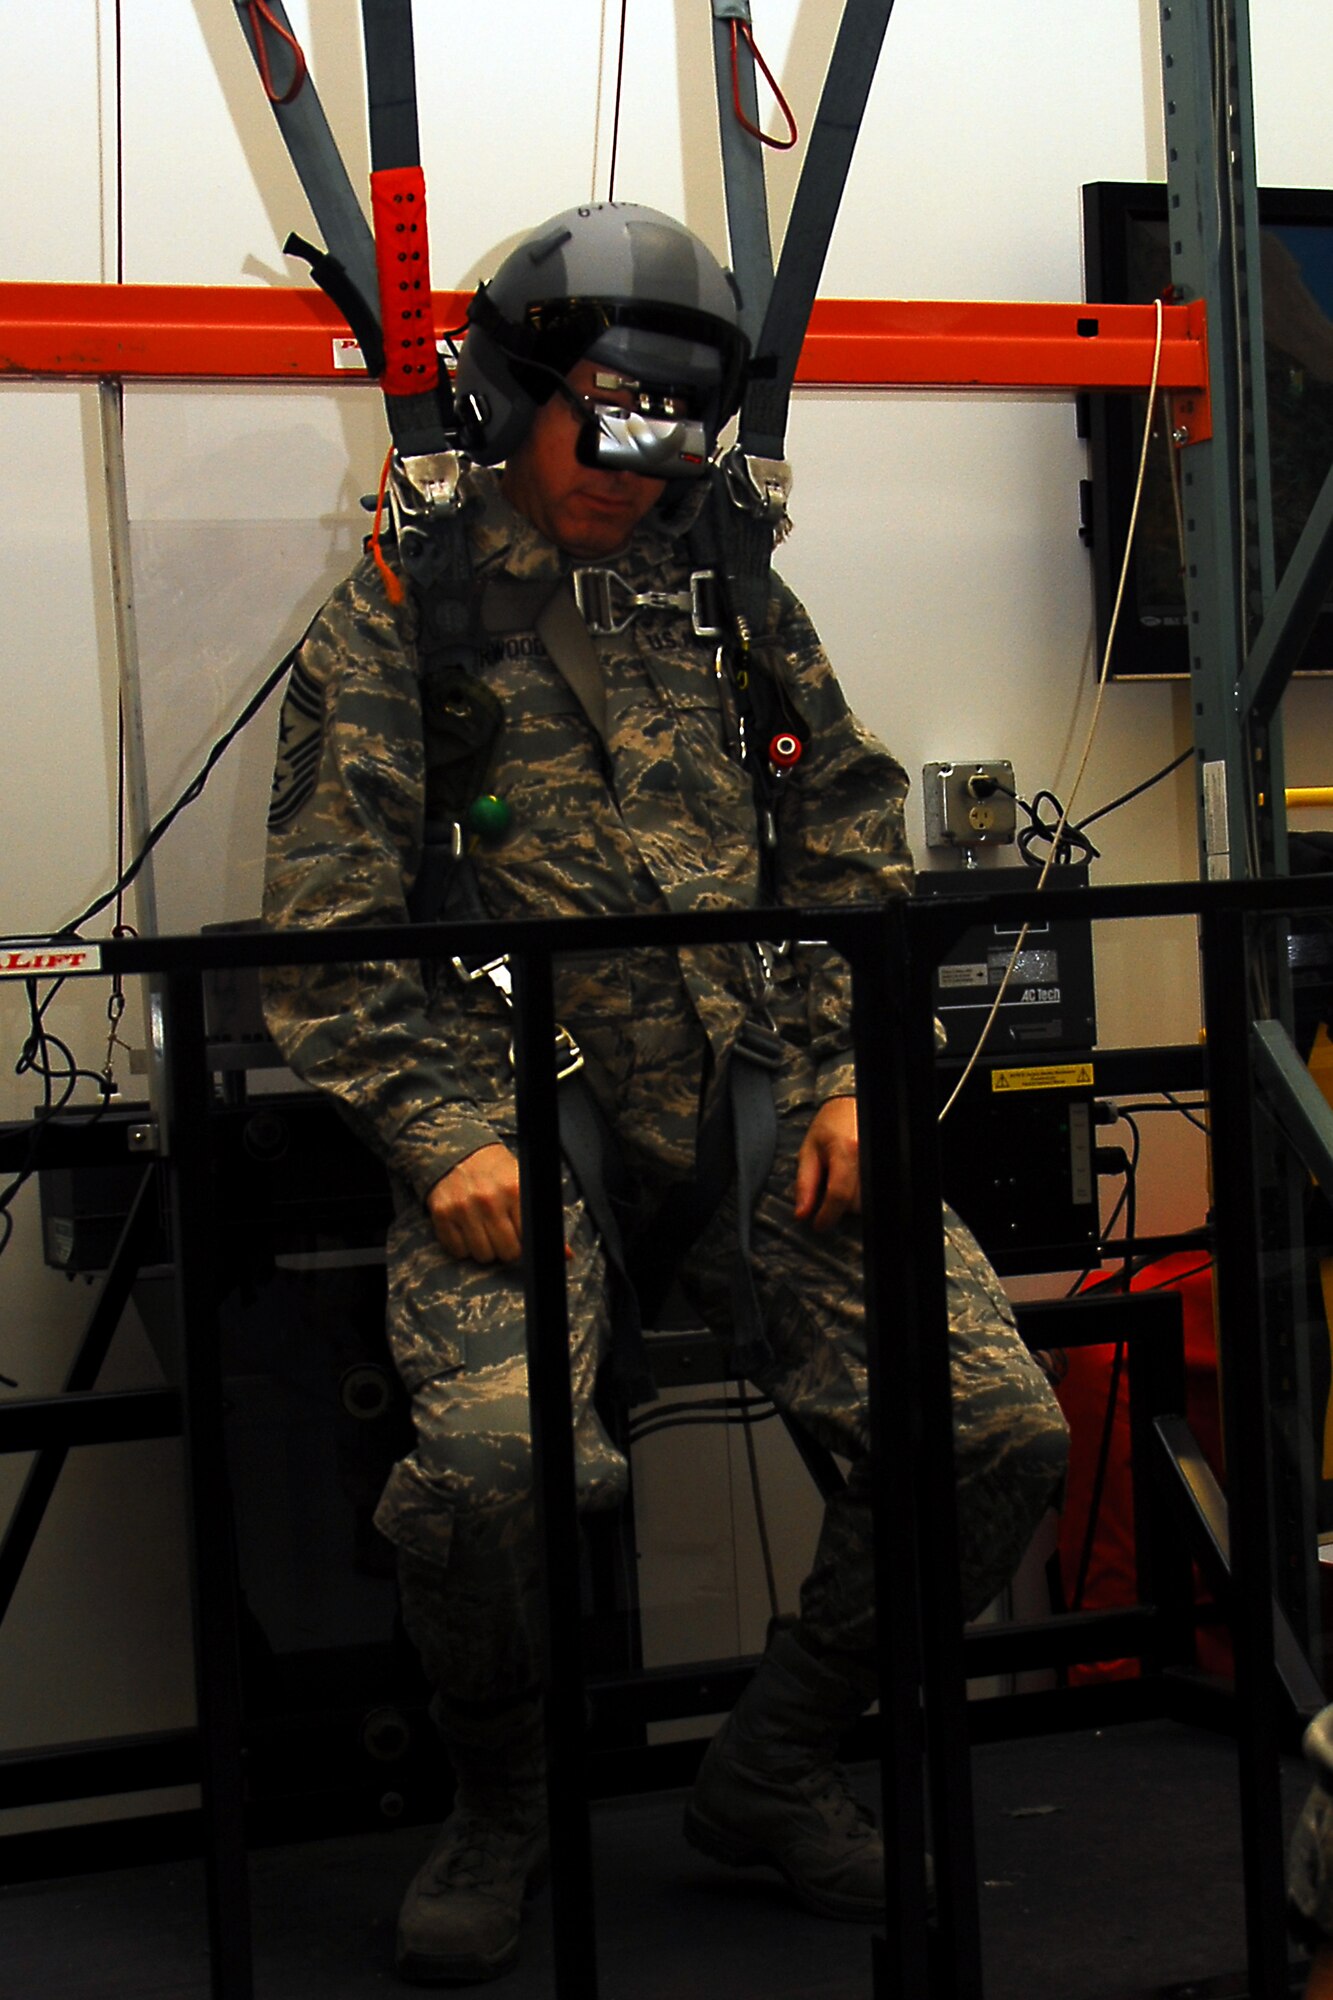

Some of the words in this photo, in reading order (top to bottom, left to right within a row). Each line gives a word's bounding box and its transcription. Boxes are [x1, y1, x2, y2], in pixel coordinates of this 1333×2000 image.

[0, 953, 86, 969] LIFT
[1020, 988, 1036, 1002] AC
[1037, 987, 1061, 1001] Tech
